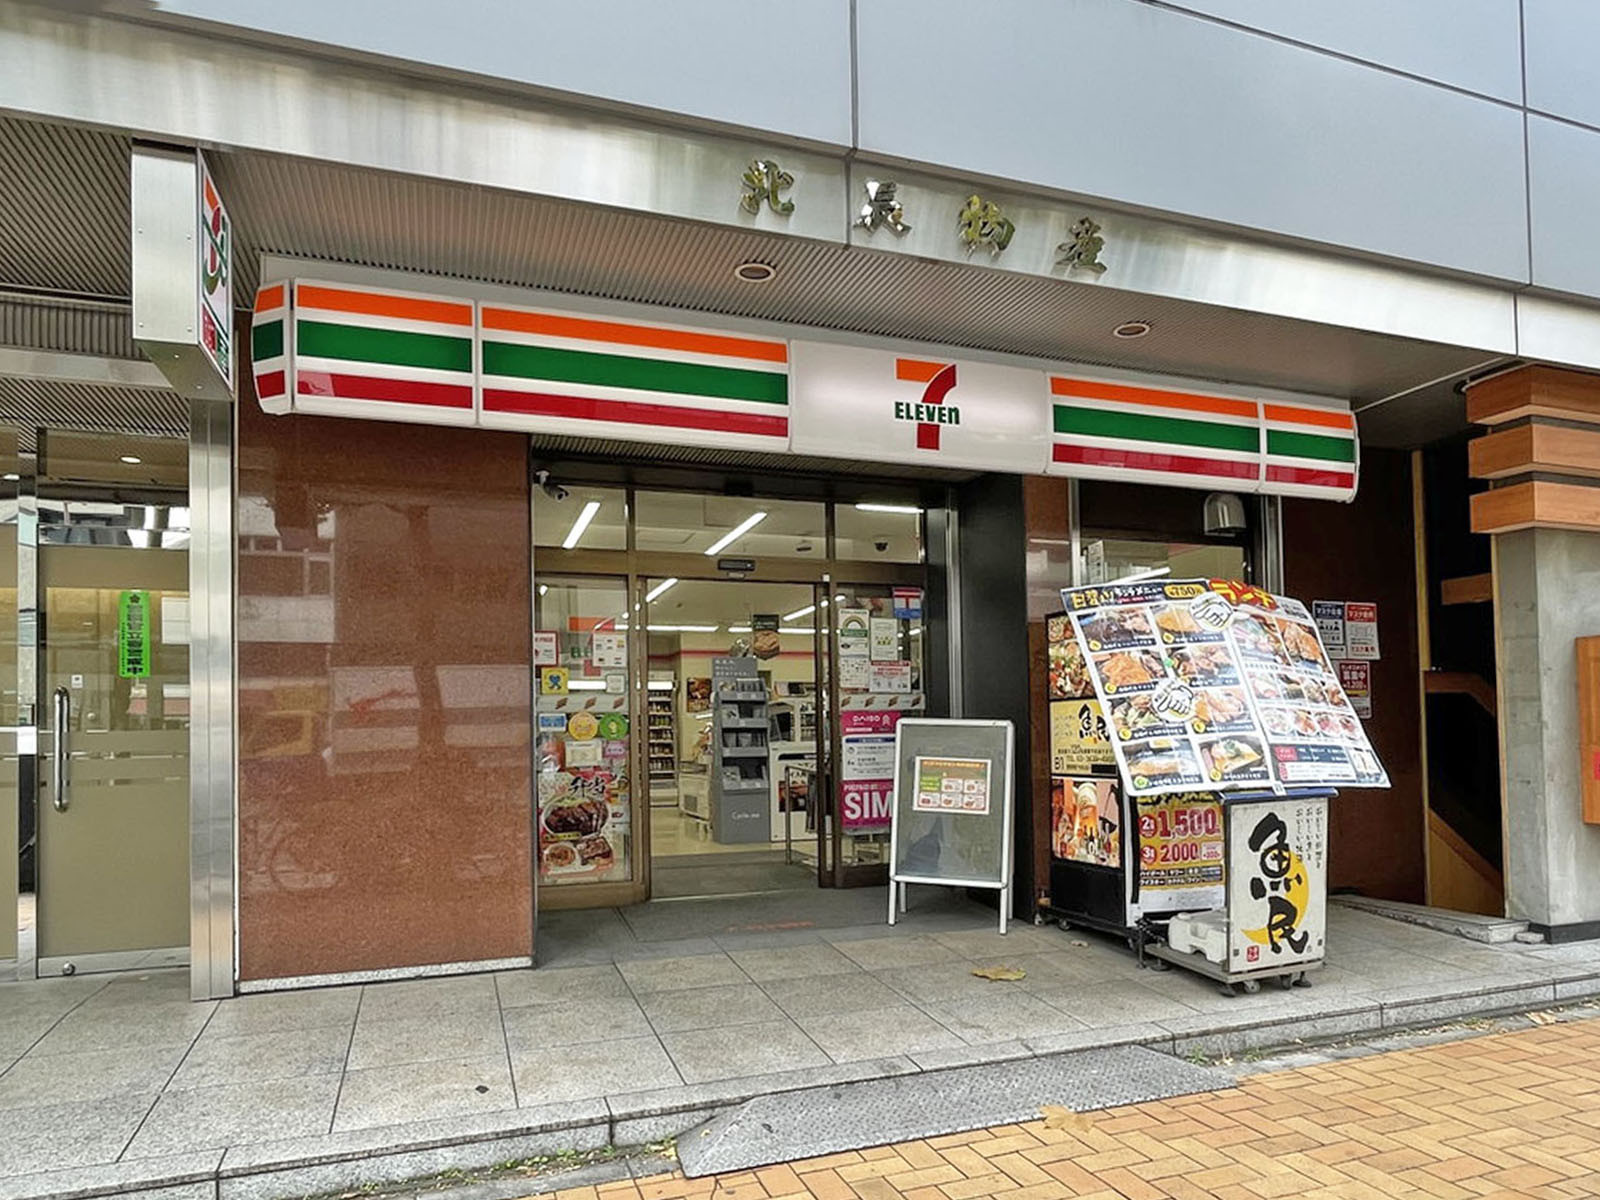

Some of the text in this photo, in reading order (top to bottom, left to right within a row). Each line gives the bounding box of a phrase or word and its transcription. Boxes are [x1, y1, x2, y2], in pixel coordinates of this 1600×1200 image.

[896, 358, 957, 450] 7
[844, 791, 894, 820] SIM
[1248, 812, 1309, 955] 魚民
